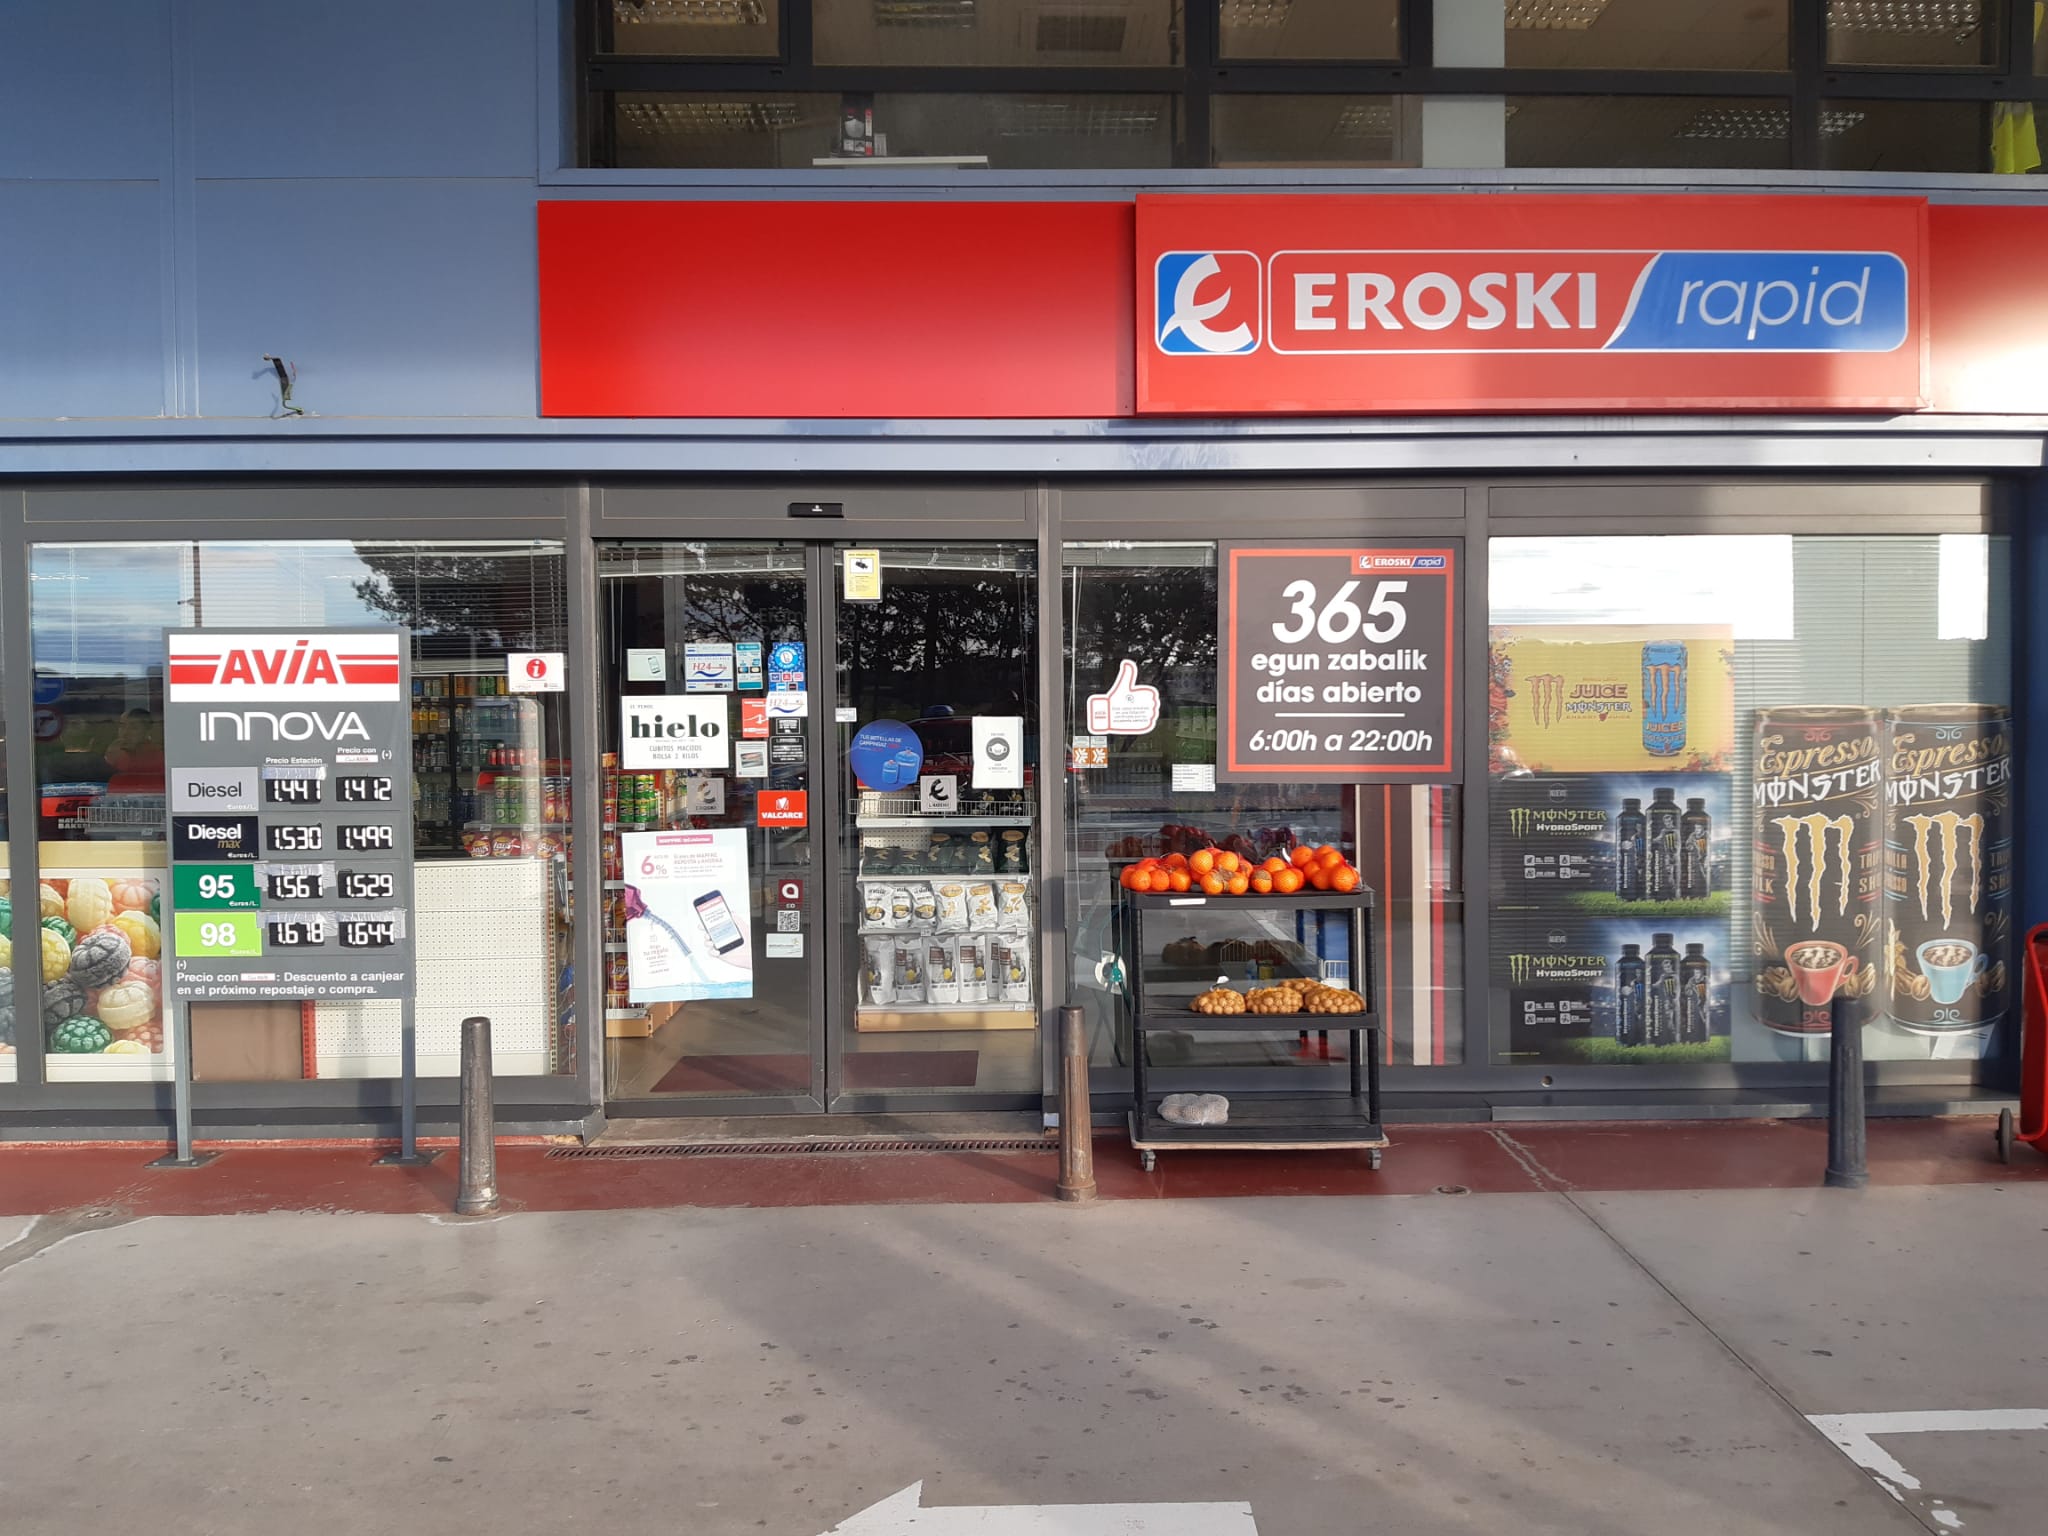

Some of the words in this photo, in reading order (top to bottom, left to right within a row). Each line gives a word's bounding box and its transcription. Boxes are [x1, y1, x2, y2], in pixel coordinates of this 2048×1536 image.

[1293, 272, 1597, 330] EROSKI
[1676, 265, 1871, 341] rapid
[1374, 558, 1411, 567] EROSKI
[1417, 557, 1442, 567] rapid
[1272, 579, 1409, 644] 365
[1251, 653, 1320, 677] egun
[1327, 649, 1428, 671] zabalik
[1256, 679, 1316, 703] días
[1322, 681, 1422, 703] abierto
[1569, 683, 1628, 699] JUICE
[1565, 700, 1633, 714] MONSTER
[200, 711, 371, 742] INNOVA
[629, 714, 720, 739] hielo
[1249, 729, 1317, 752] 6:00h
[1324, 734, 1343, 752] a
[1349, 729, 1433, 752] 22:00h
[265, 757, 289, 765] Precio
[290, 757, 323, 765] Estación
[1759, 734, 1875, 779] Espresso
[1891, 733, 2009, 778] Espresso
[187, 781, 243, 798] Diesel
[345, 778, 392, 801] 1.412
[1753, 759, 1882, 808] MONSTER
[1885, 757, 2012, 807] MONSTER
[761, 811, 804, 819] VALCARCE
[1533, 808, 1608, 823] MONSTER
[187, 824, 242, 841] Diesel
[274, 827, 322, 850] 1.530
[345, 826, 393, 849] 1.499
[217, 840, 241, 850] max
[198, 874, 235, 899] 95
[276, 875, 323, 898] 1.561
[346, 874, 393, 898] 1.529
[199, 922, 236, 948] 98
[348, 922, 395, 945] 1.644
[1532, 954, 1607, 968] MONSTER
[176, 972, 212, 983] Precio
[216, 974, 239, 983] con
[283, 971, 345, 983] Descuento
[350, 974, 358, 982] a
[361, 971, 406, 985] canjear
[176, 987, 192, 996] en
[200, 985, 206, 996] el
[208, 984, 254, 999] próximo
[259, 985, 315, 999] repostaje
[318, 987, 327, 996] o
[330, 987, 378, 999] compra.
